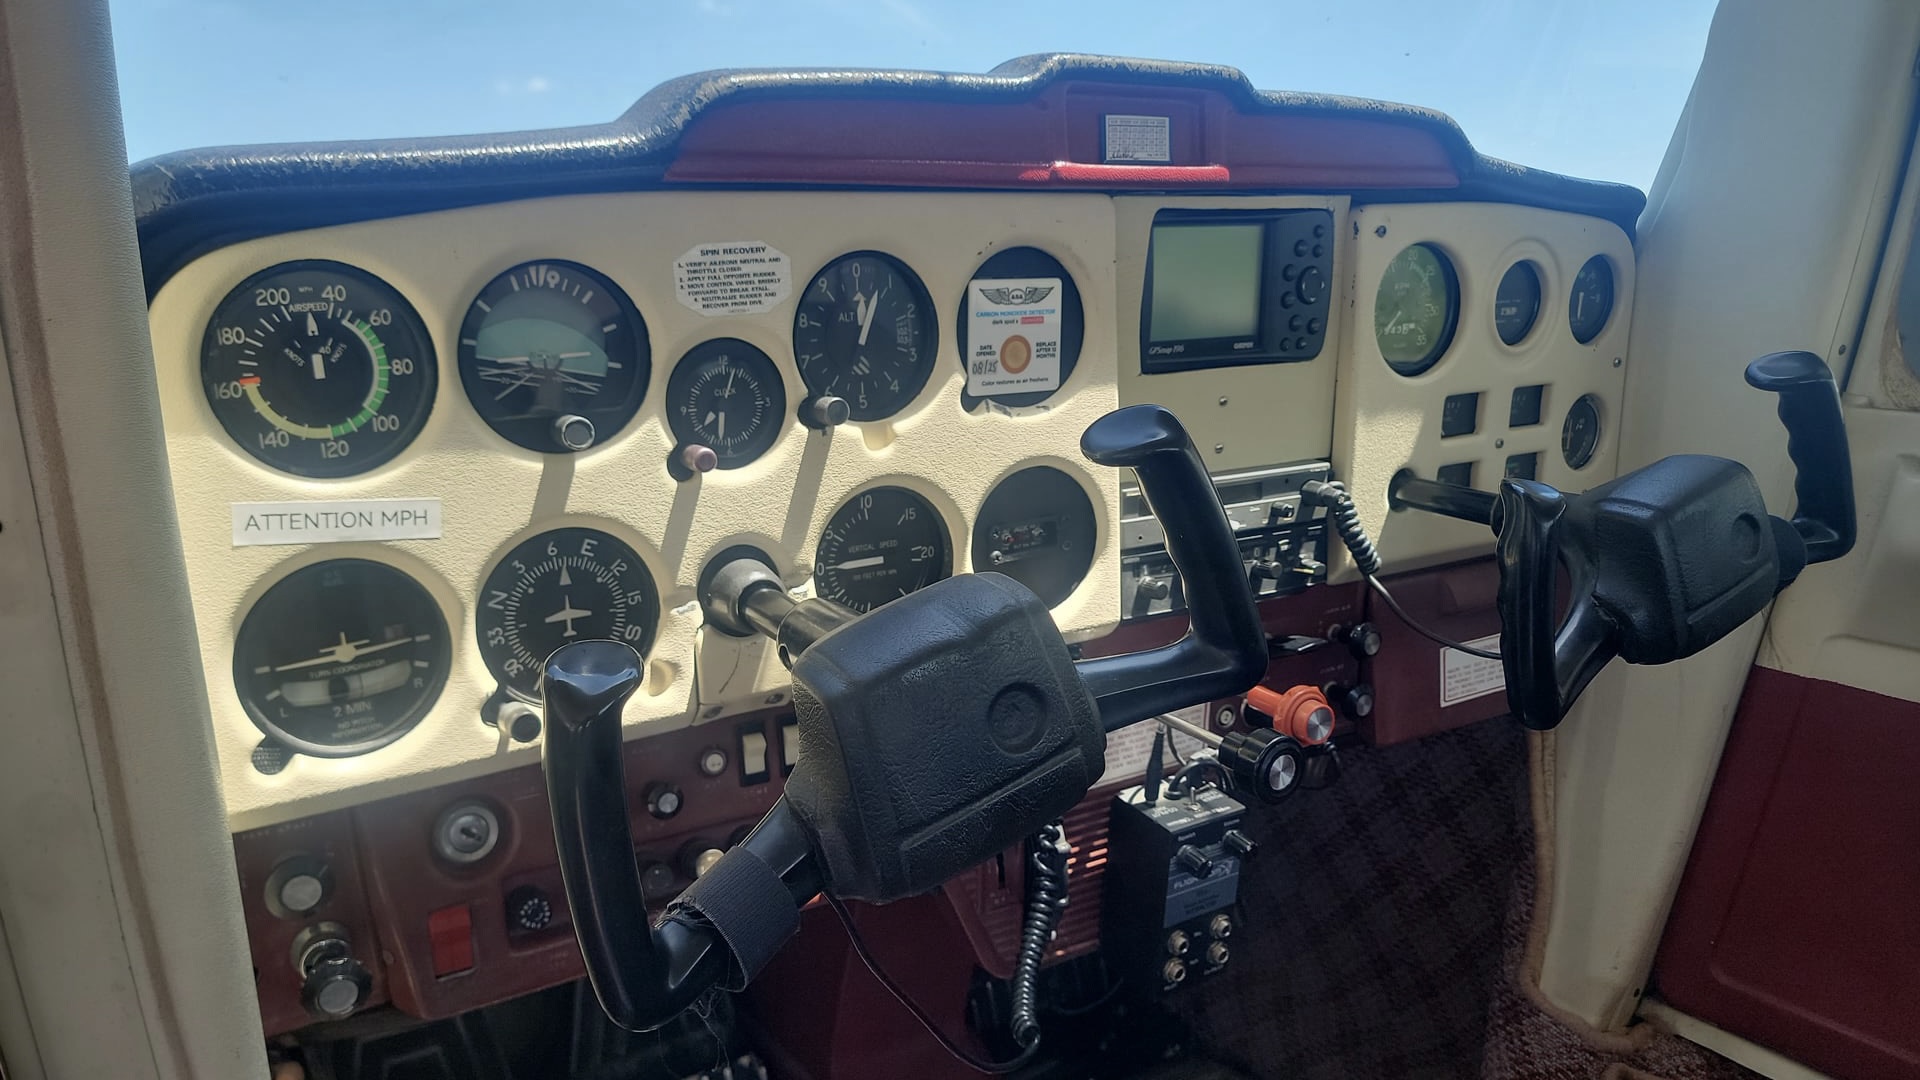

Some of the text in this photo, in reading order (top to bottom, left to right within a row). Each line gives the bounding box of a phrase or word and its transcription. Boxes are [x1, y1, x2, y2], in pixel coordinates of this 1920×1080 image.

[700, 246, 766, 256] SPIN RECOVERY
[852, 263, 861, 278] 0
[818, 278, 828, 293] 9
[256, 288, 290, 306] 200
[321, 285, 346, 302] 40
[702, 294, 736, 302] NEUTRALIZE
[289, 302, 329, 313] AIRSPEED
[908, 304, 916, 318] 2
[1028, 308, 1056, 316] DETECTOR
[370, 309, 392, 327] 60
[800, 314, 808, 328] 8
[838, 312, 856, 322] ALT
[217, 327, 246, 346] 180
[330, 343, 348, 363] KNOTS
[1233, 342, 1254, 350] GARMIN
[284, 348, 306, 368] KNOTS
[719, 355, 728, 365] 12
[801, 355, 810, 370] 7
[909, 348, 918, 362] 3
[392, 358, 414, 376] 80
[972, 360, 998, 376] 08/25
[214, 381, 242, 400] 160
[890, 380, 900, 394] 4
[764, 397, 772, 408] 3
[859, 394, 868, 409] 5
[680, 406, 686, 416] 9
[372, 415, 400, 432] 100
[258, 431, 290, 449] 140
[320, 442, 350, 459] 120
[860, 494, 873, 510] 10
[244, 508, 428, 532] ATTENTION MPH
[905, 507, 916, 520] 15
[547, 541, 558, 556] 6
[580, 538, 599, 557] E
[848, 539, 898, 553] VERTICAL SPEED
[920, 546, 935, 558] 20
[512, 560, 526, 574] 3
[610, 558, 628, 577] 12
[816, 562, 825, 576] 0
[487, 590, 508, 610] N
[627, 590, 642, 606] 15
[487, 627, 505, 648] 33
[624, 624, 642, 642] S
[309, 659, 386, 680] TURN COORDINATOR
[504, 658, 524, 678] 30
[414, 678, 424, 688] R
[280, 708, 288, 718] L
[332, 701, 372, 718] 2 MIN
